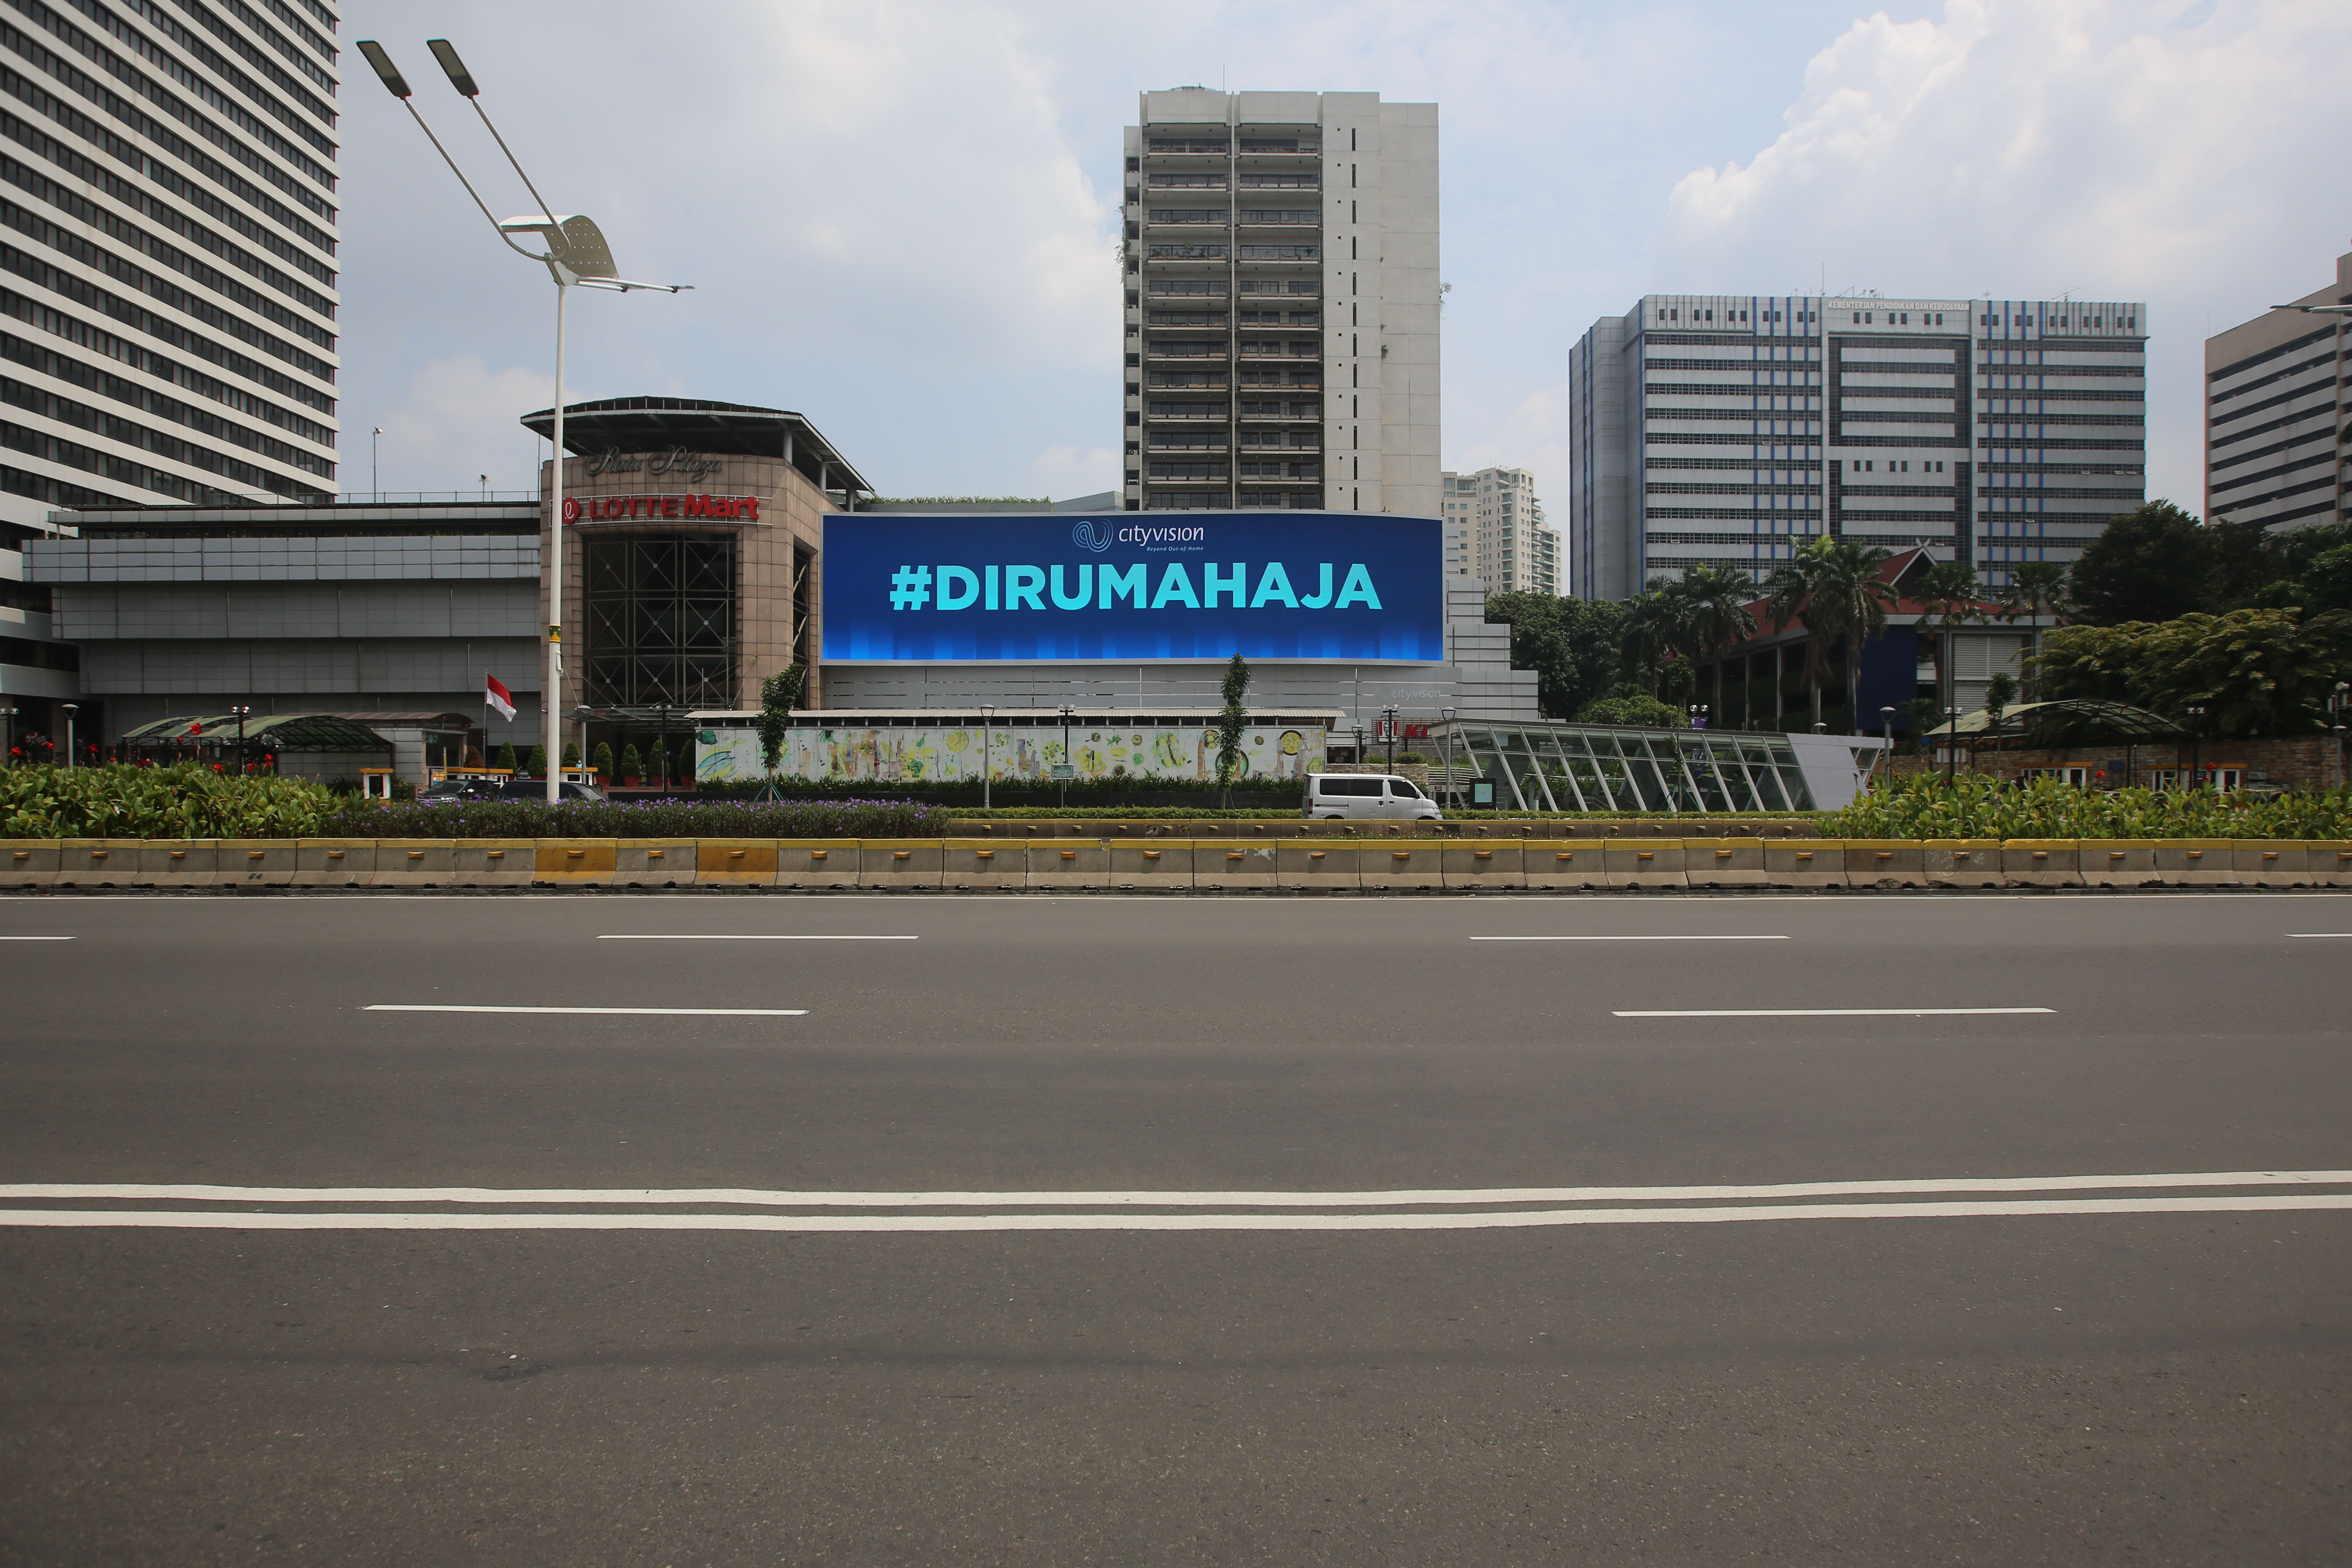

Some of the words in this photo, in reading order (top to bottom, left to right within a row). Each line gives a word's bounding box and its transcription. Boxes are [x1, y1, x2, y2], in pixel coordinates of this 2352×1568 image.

[1828, 301, 1874, 309] KEMENTERIAN
[1876, 302, 1914, 310] PENDIDIKAN
[1929, 303, 1969, 311] KEBUDAYAAN
[647, 445, 723, 482] Plaza
[1119, 525, 1204, 546] cityvision
[890, 562, 1382, 611] #DIRUMAHAJA
